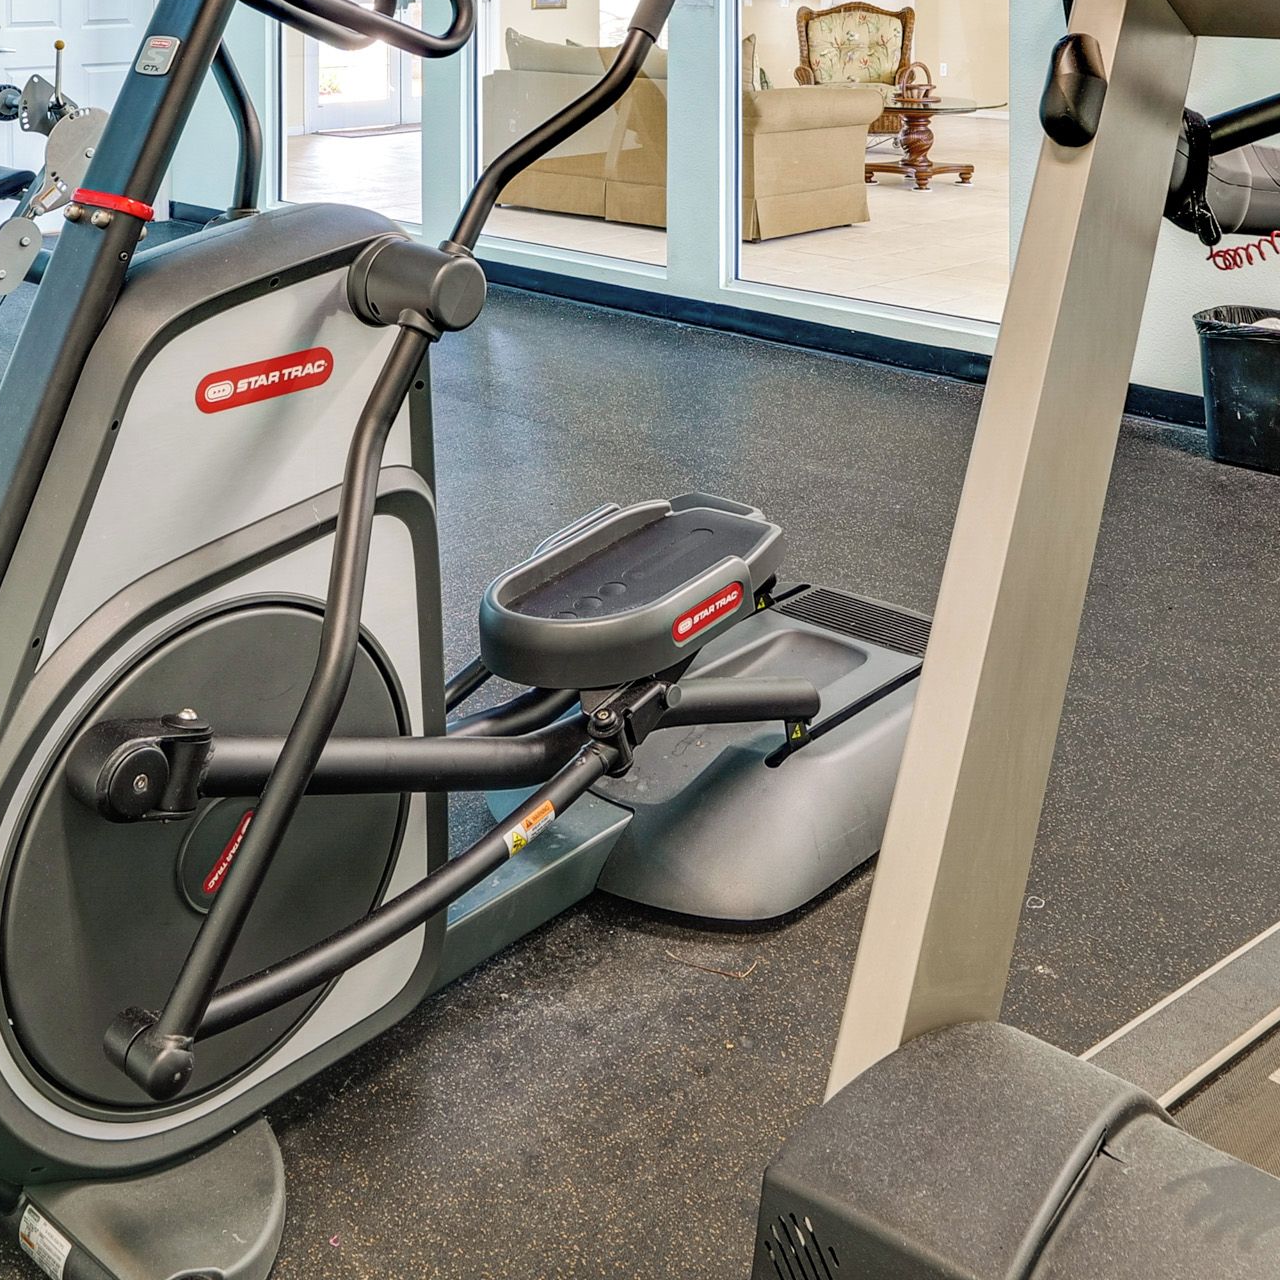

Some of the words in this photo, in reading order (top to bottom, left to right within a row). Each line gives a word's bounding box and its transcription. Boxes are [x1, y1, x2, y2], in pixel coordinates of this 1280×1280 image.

[236, 371, 280, 393] STAR
[281, 358, 326, 381] TRAC
[693, 604, 716, 625] STAR
[715, 589, 739, 610] TRAC
